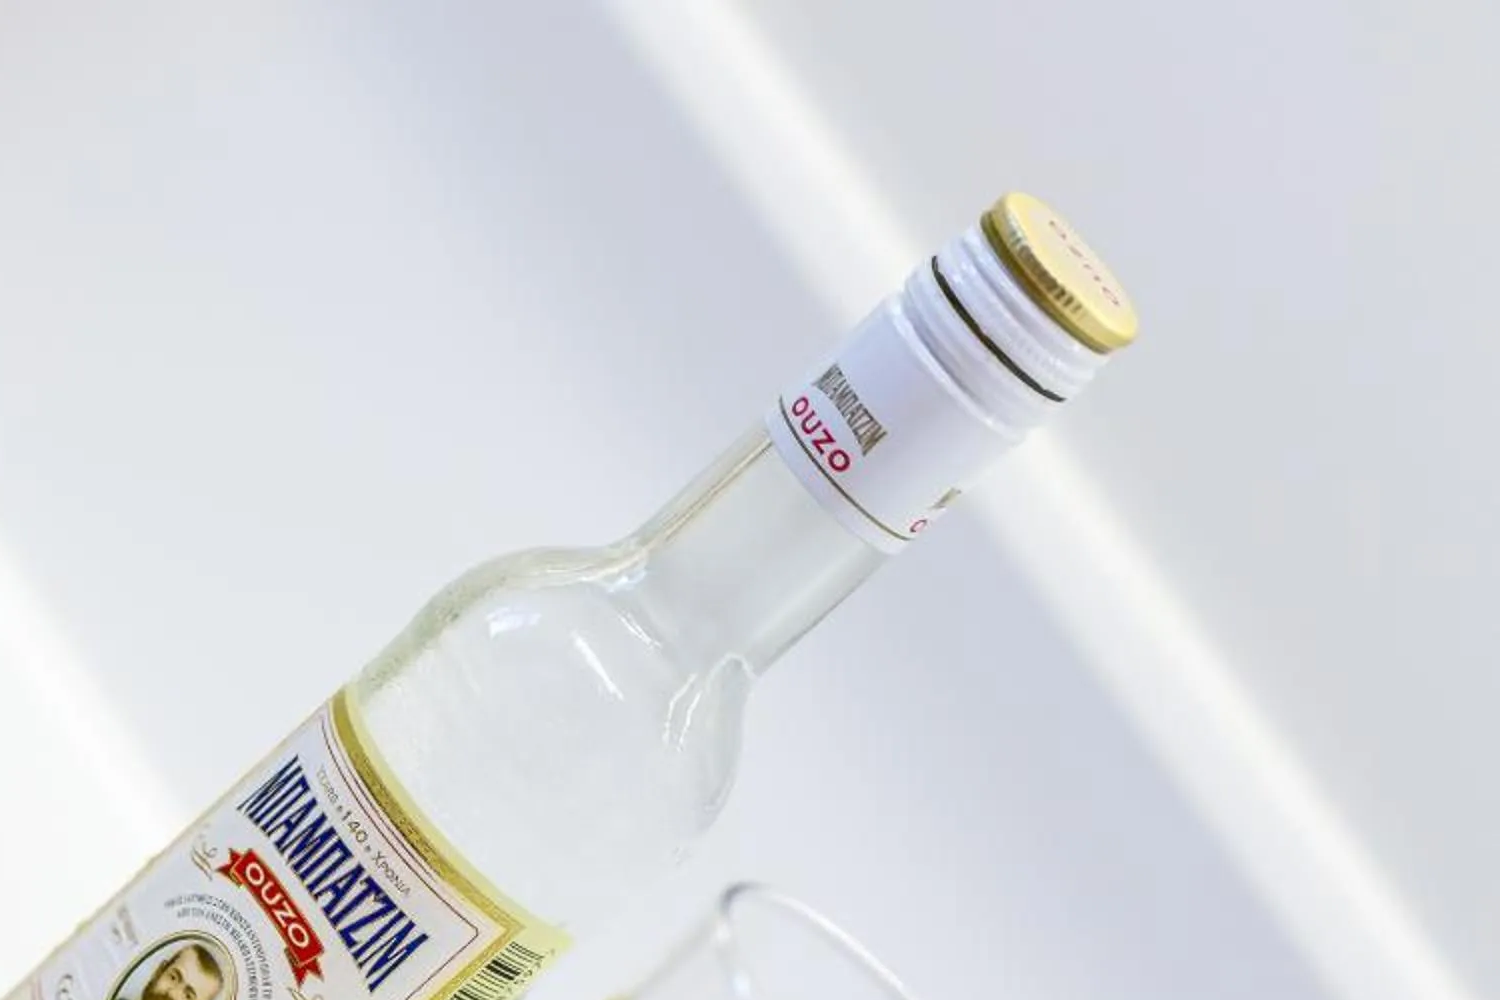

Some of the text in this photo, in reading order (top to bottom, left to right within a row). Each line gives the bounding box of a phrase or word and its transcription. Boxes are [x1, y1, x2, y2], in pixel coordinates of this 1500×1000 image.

[791, 396, 851, 473] OUZO
[342, 811, 368, 843] 140
[245, 859, 312, 950] OUZO
